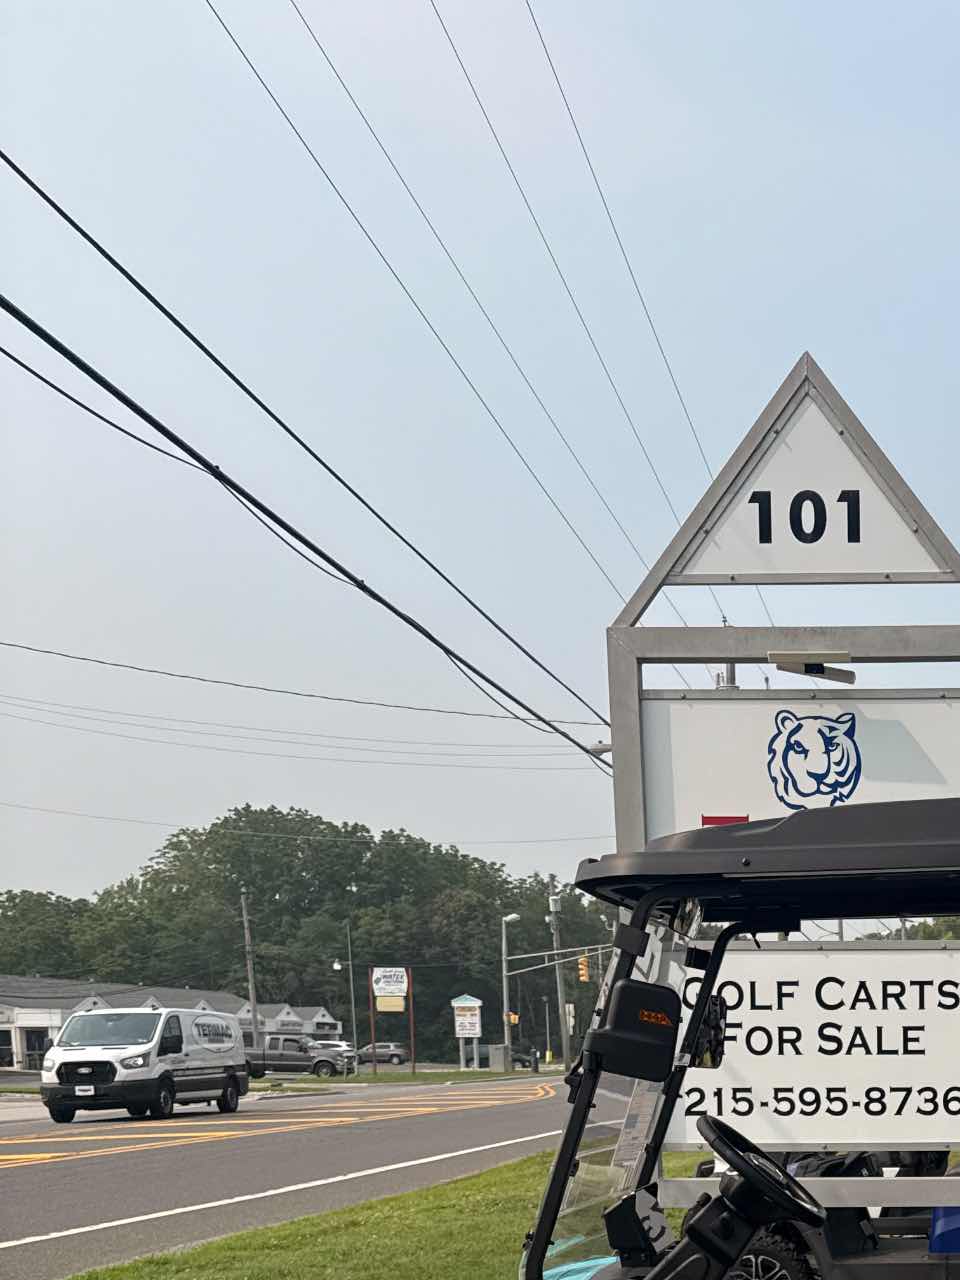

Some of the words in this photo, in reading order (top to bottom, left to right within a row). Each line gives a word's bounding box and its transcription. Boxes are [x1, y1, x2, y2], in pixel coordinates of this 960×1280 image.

[748, 490, 861, 544] 101
[683, 977, 800, 1012] GOLF
[814, 976, 960, 1011] CARTS
[724, 1022, 803, 1056] FOR
[817, 1021, 926, 1056] SALE
